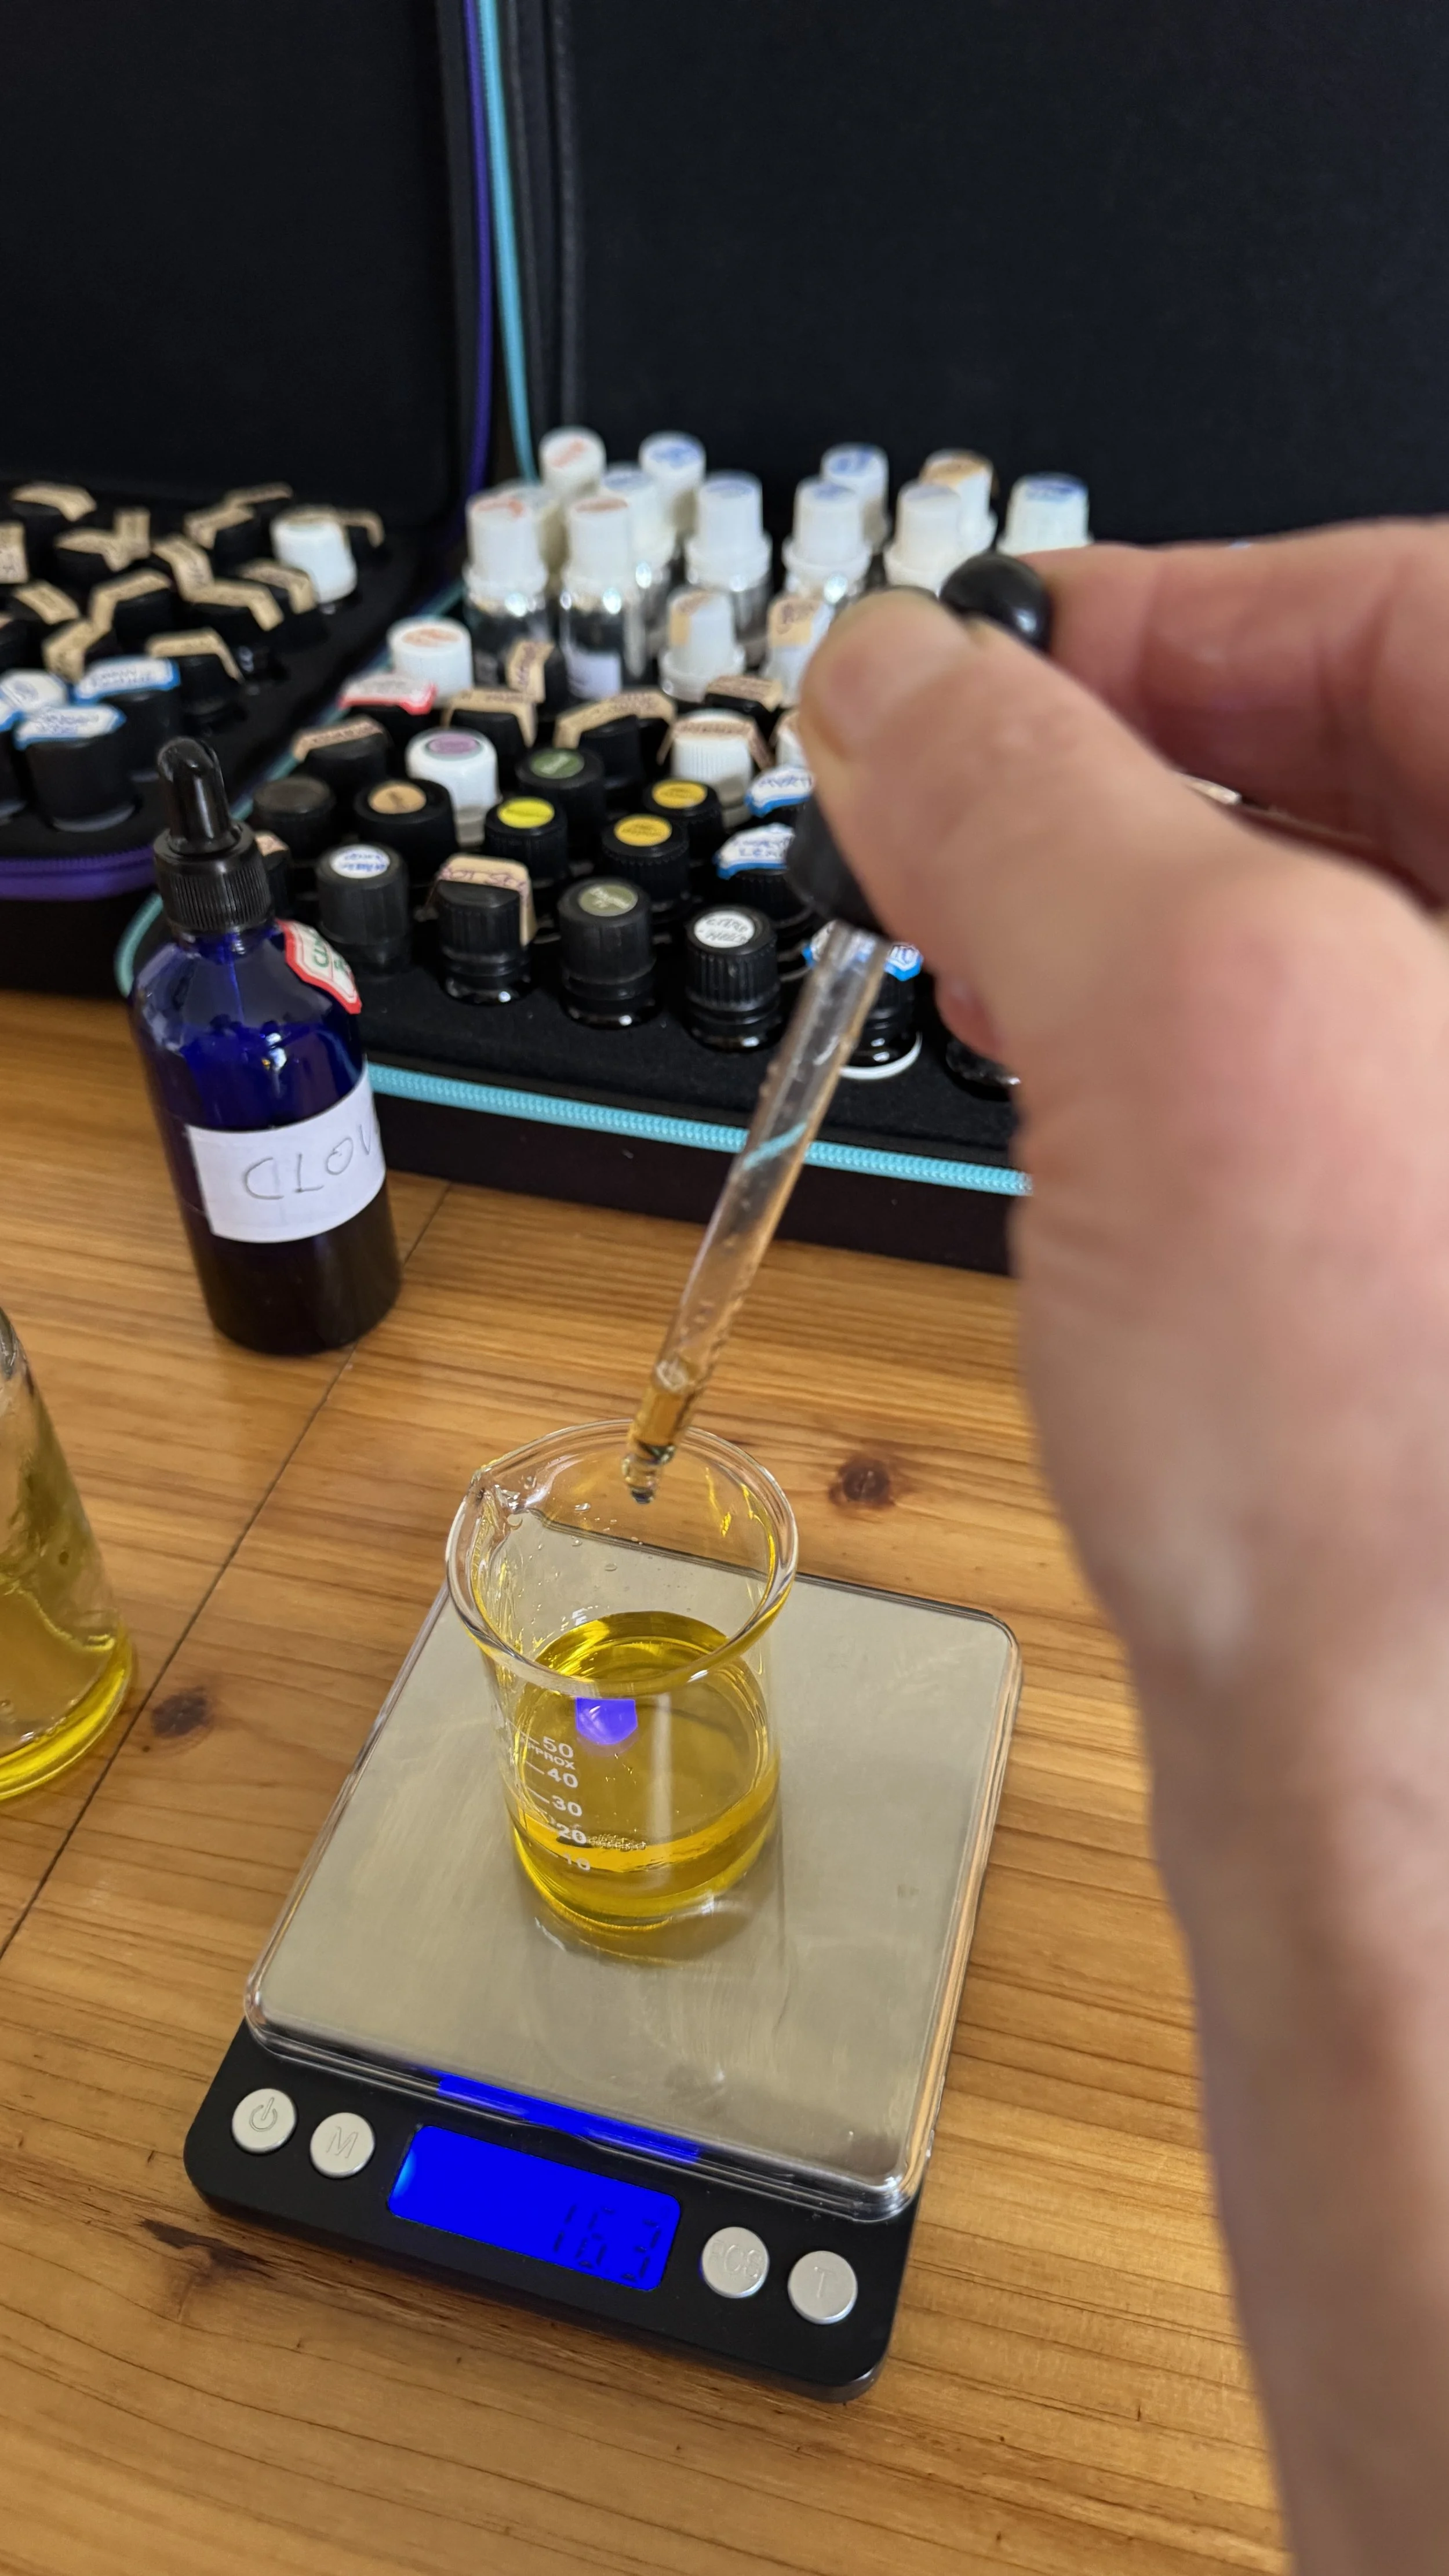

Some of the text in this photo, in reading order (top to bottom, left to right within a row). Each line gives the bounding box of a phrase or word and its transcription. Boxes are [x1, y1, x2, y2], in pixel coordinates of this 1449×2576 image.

[244, 1118, 378, 1200] CLOV
[543, 1735, 574, 1758] 50
[547, 1767, 578, 1788] 40
[552, 1795, 582, 1817] 30
[556, 1822, 587, 1844] 20
[564, 1853, 591, 1871] 10
[326, 2126, 358, 2159] M
[814, 2266, 836, 2299] T
